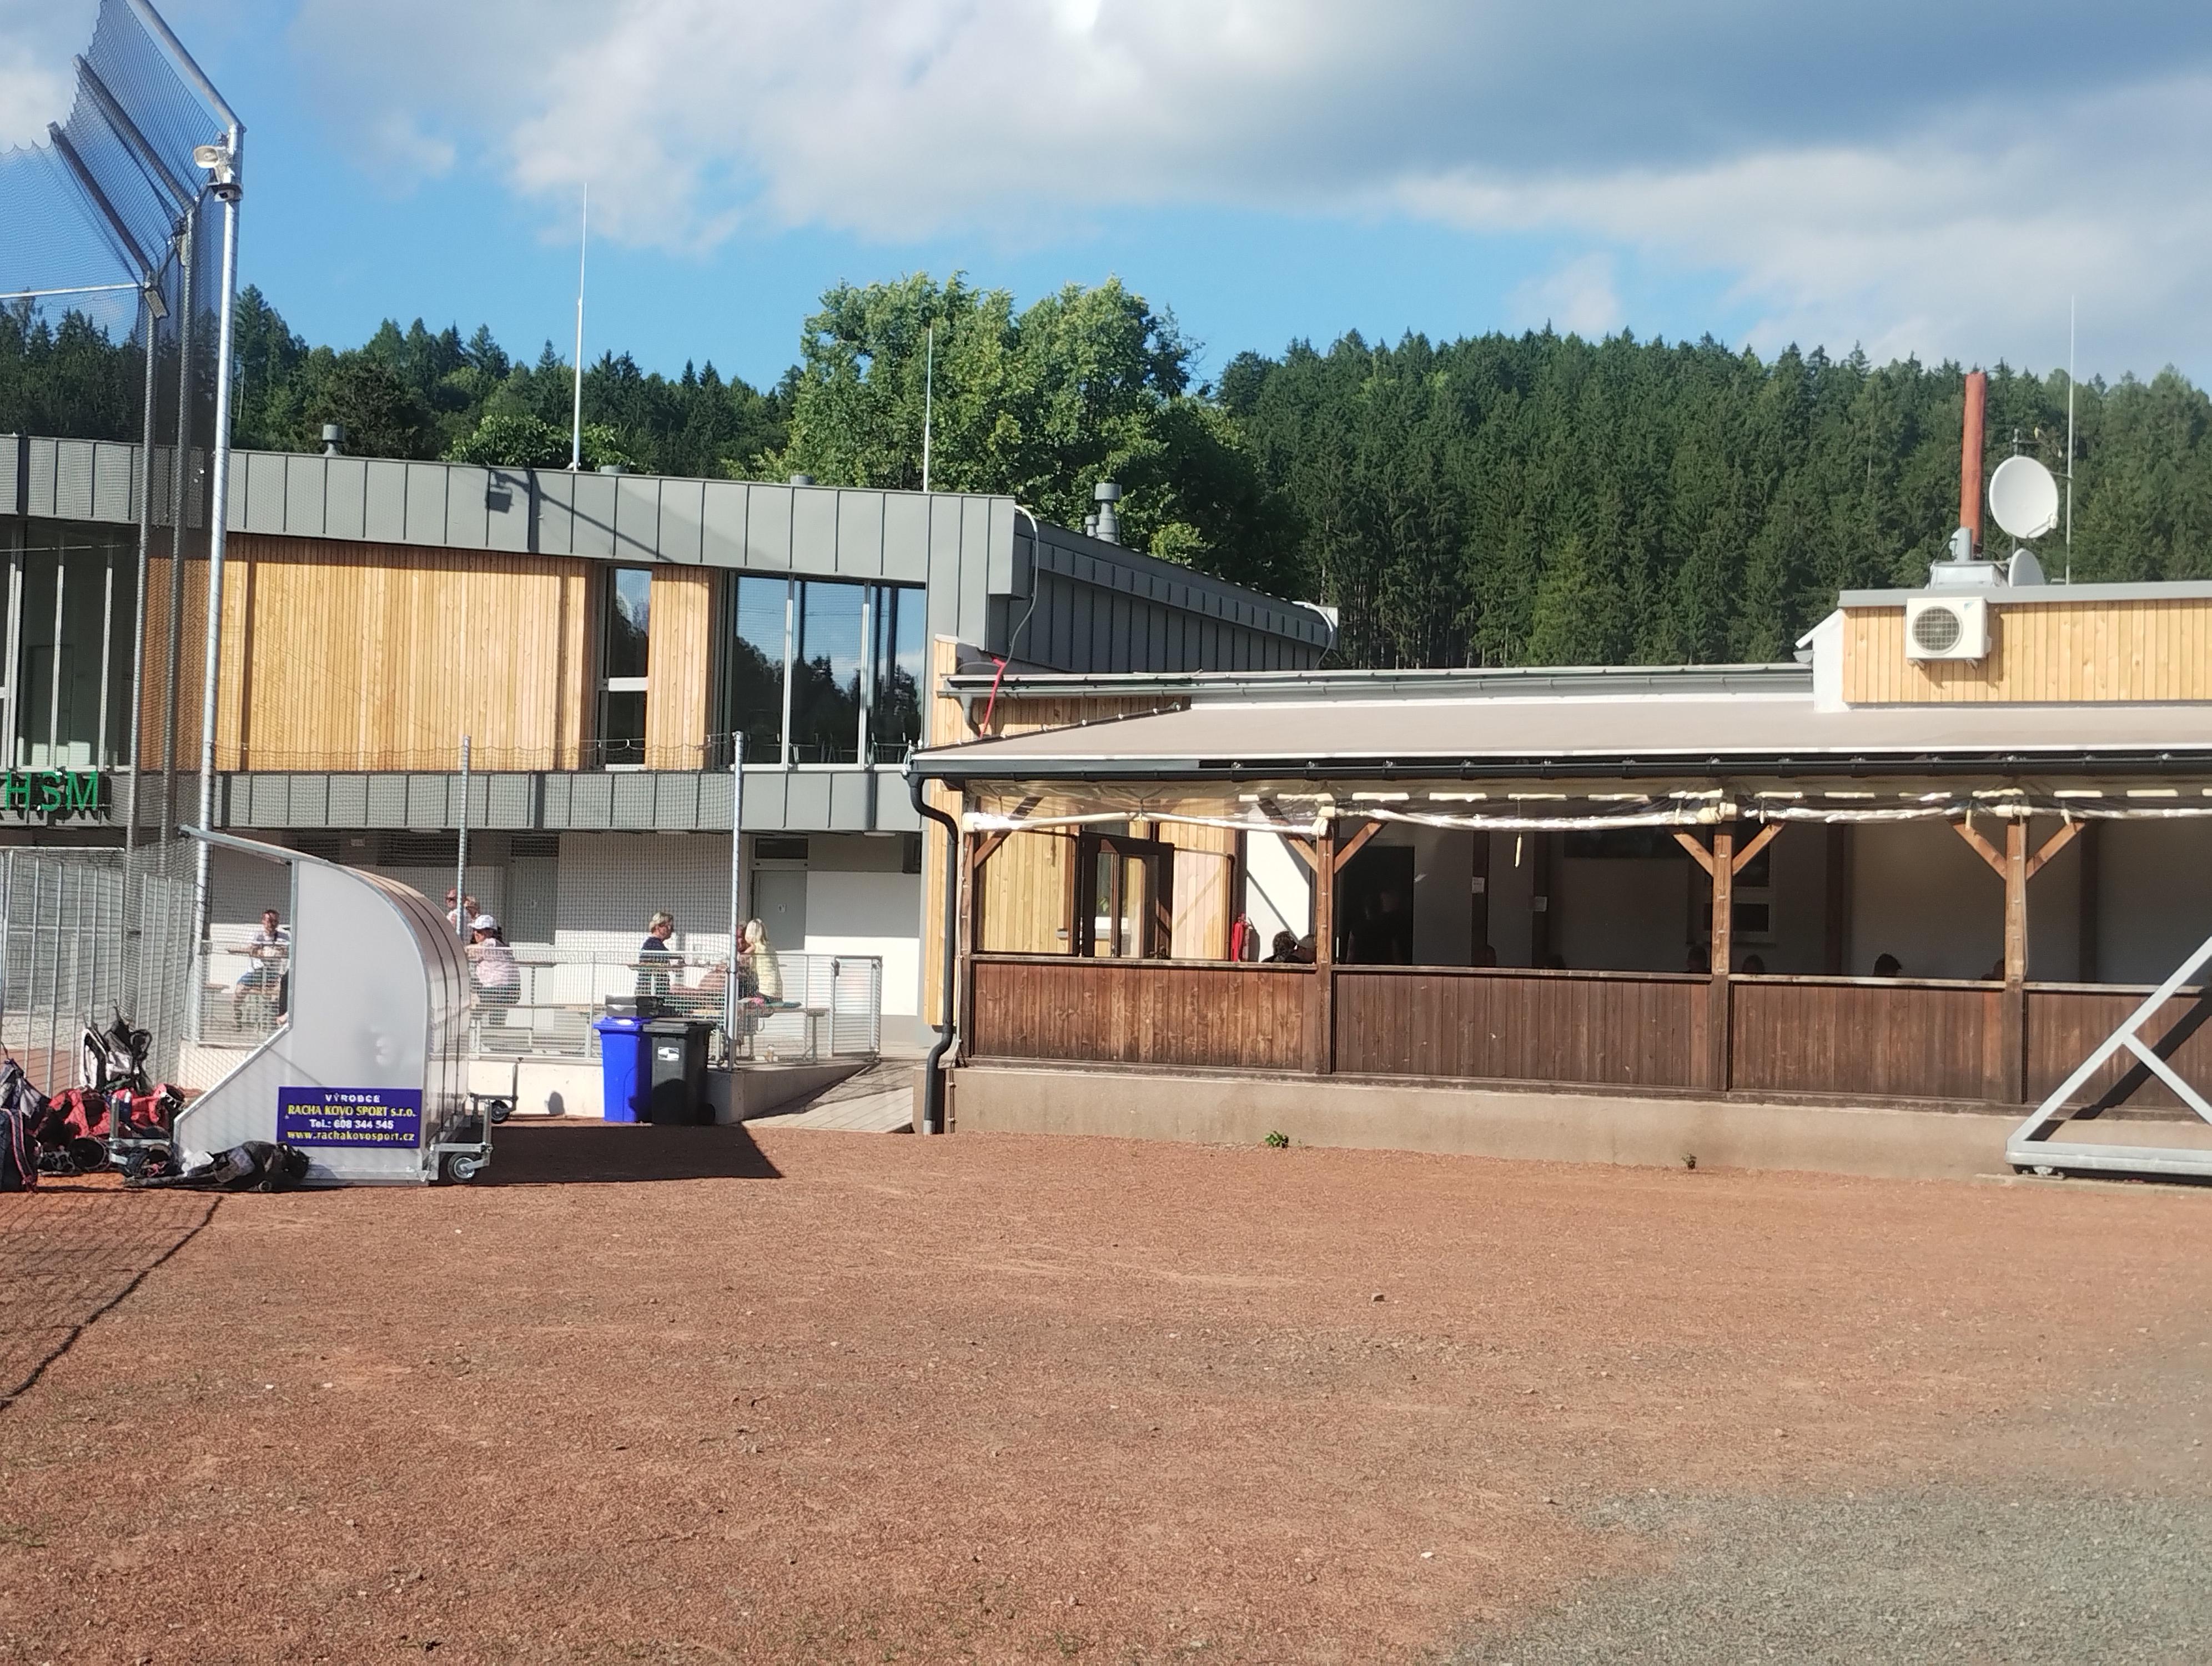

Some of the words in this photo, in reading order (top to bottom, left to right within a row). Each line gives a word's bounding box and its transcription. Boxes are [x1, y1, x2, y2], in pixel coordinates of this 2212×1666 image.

[5, 770, 98, 811] HSM
[288, 1105, 322, 1115] RACHA
[324, 1105, 354, 1116] KOVO
[356, 1106, 387, 1116] SPORT
[287, 1130, 415, 1142] www.rachakovosport.cz
